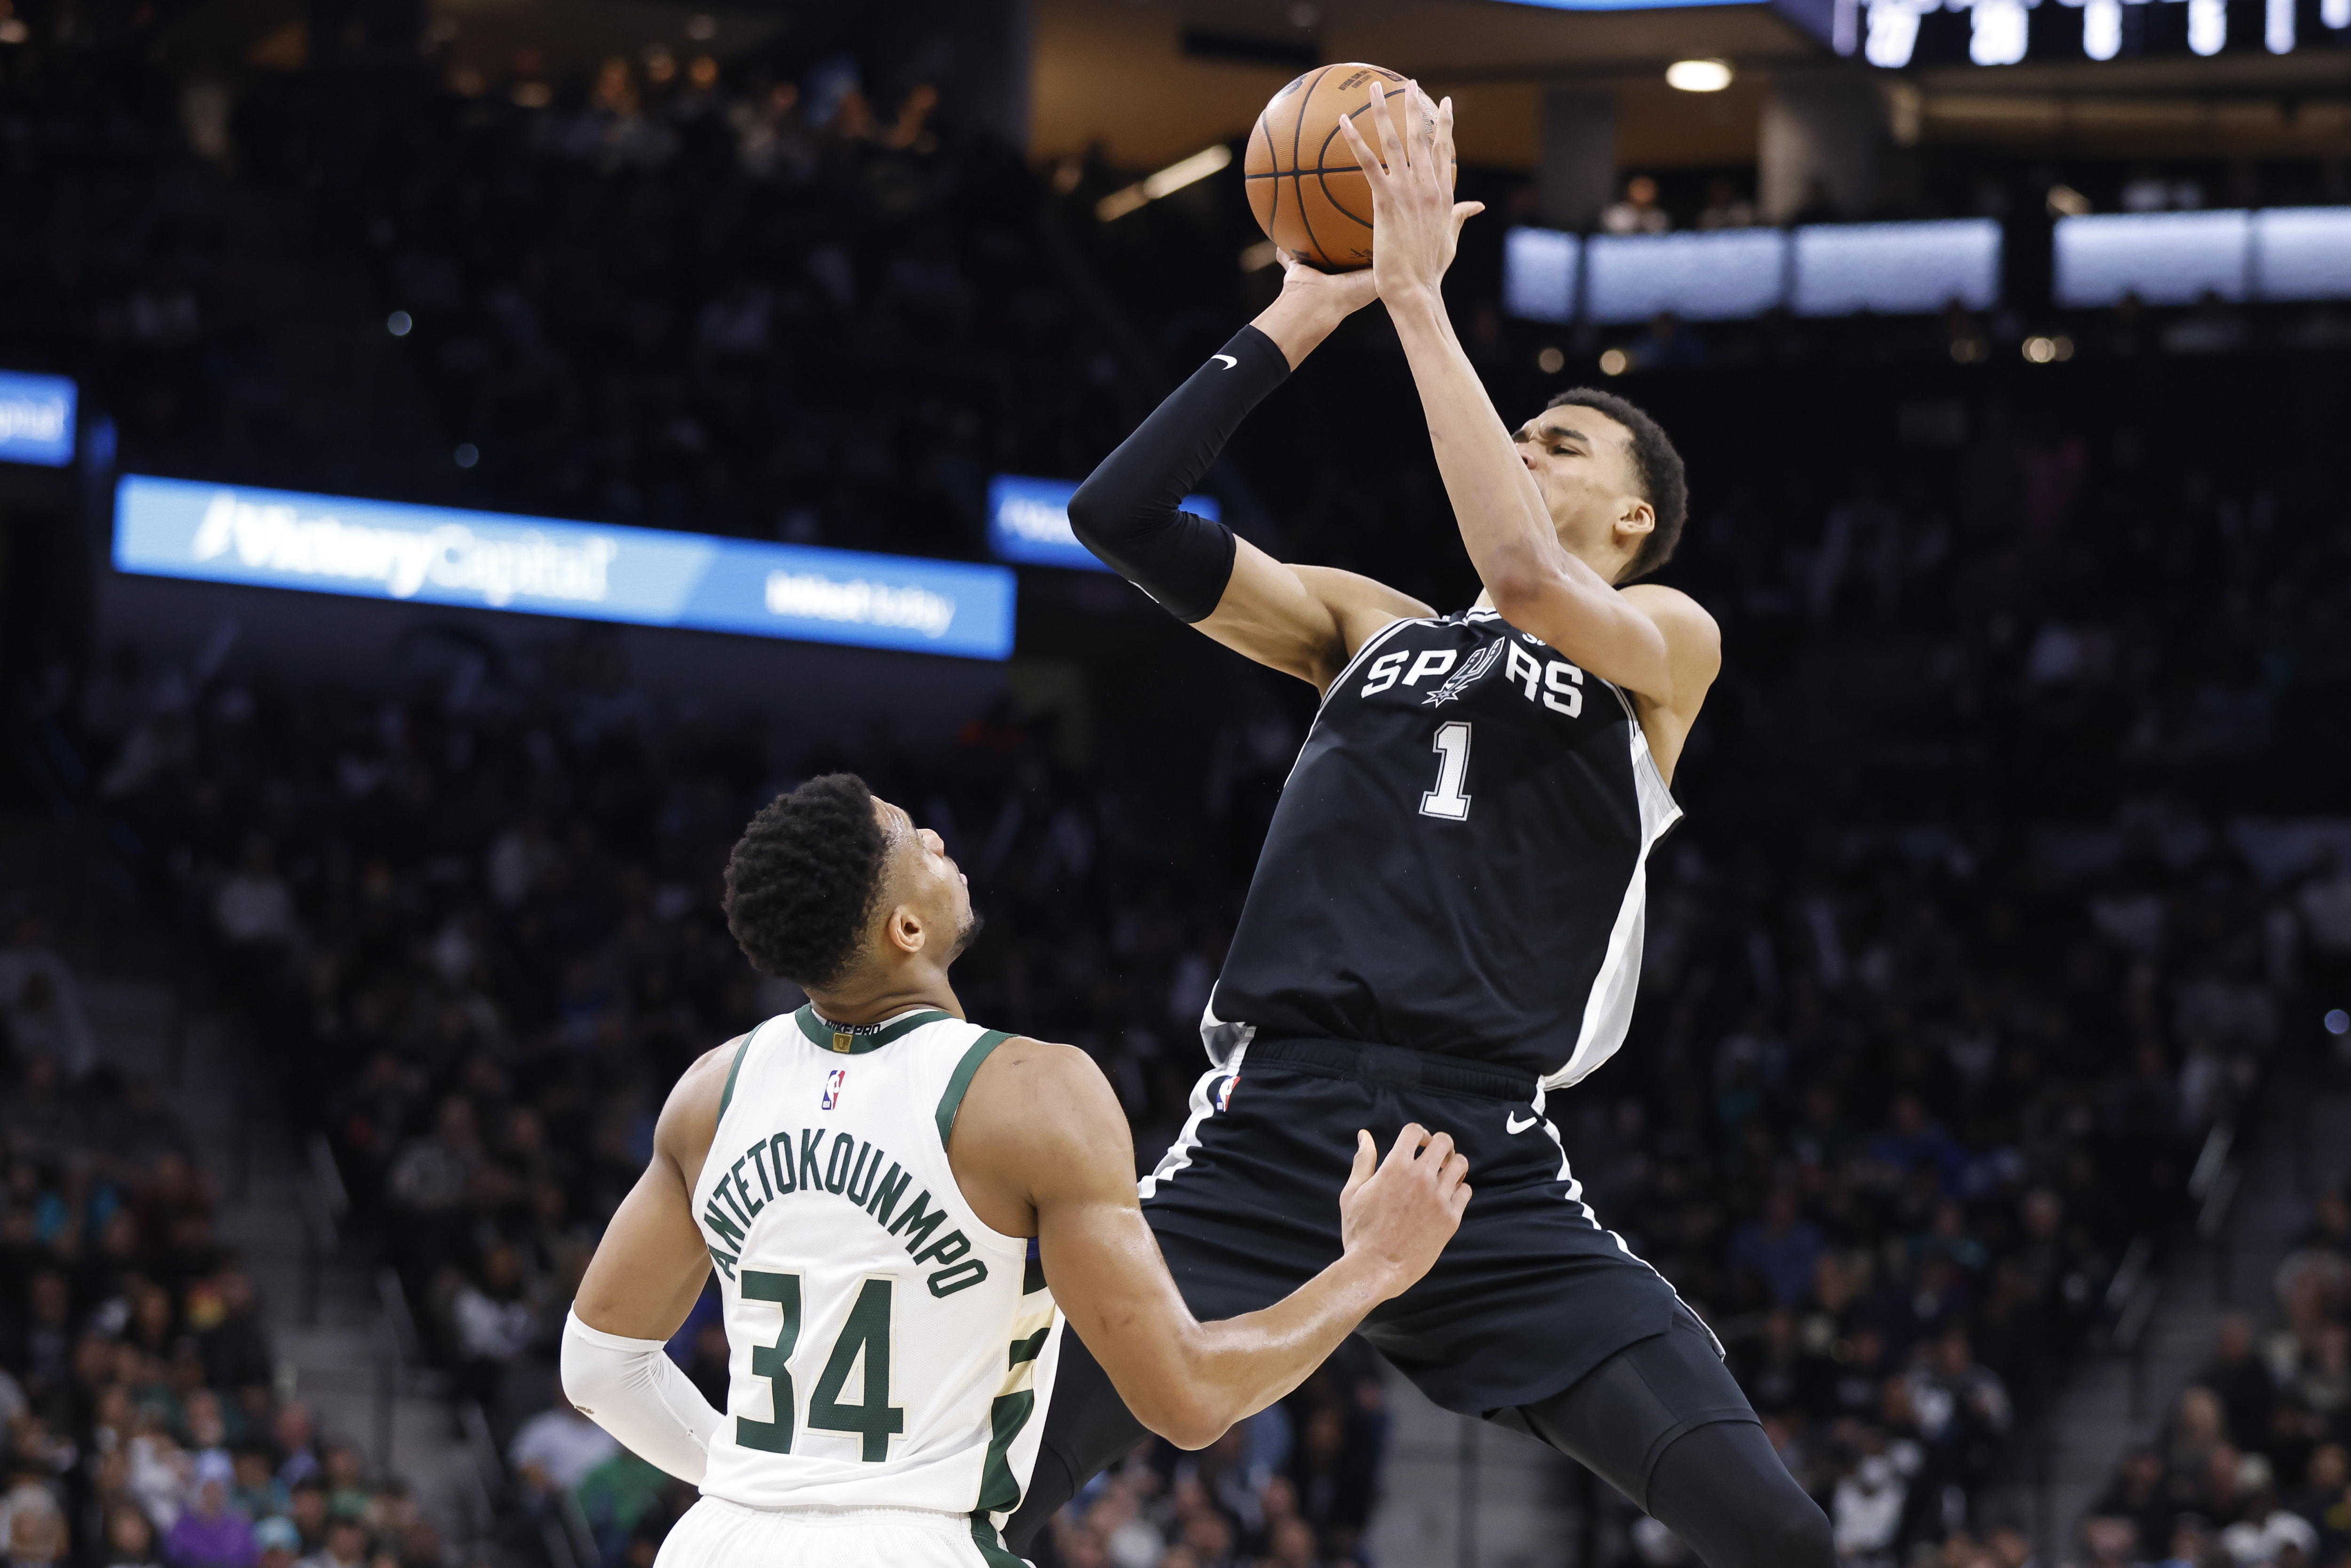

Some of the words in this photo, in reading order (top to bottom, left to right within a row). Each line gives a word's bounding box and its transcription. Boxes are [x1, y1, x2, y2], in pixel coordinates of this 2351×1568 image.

[1419, 721, 1472, 821] 1
[853, 1024, 881, 1035] PRO
[704, 1128, 988, 1299] ANTETOKOUNMPO
[735, 1265, 909, 1463] 34
